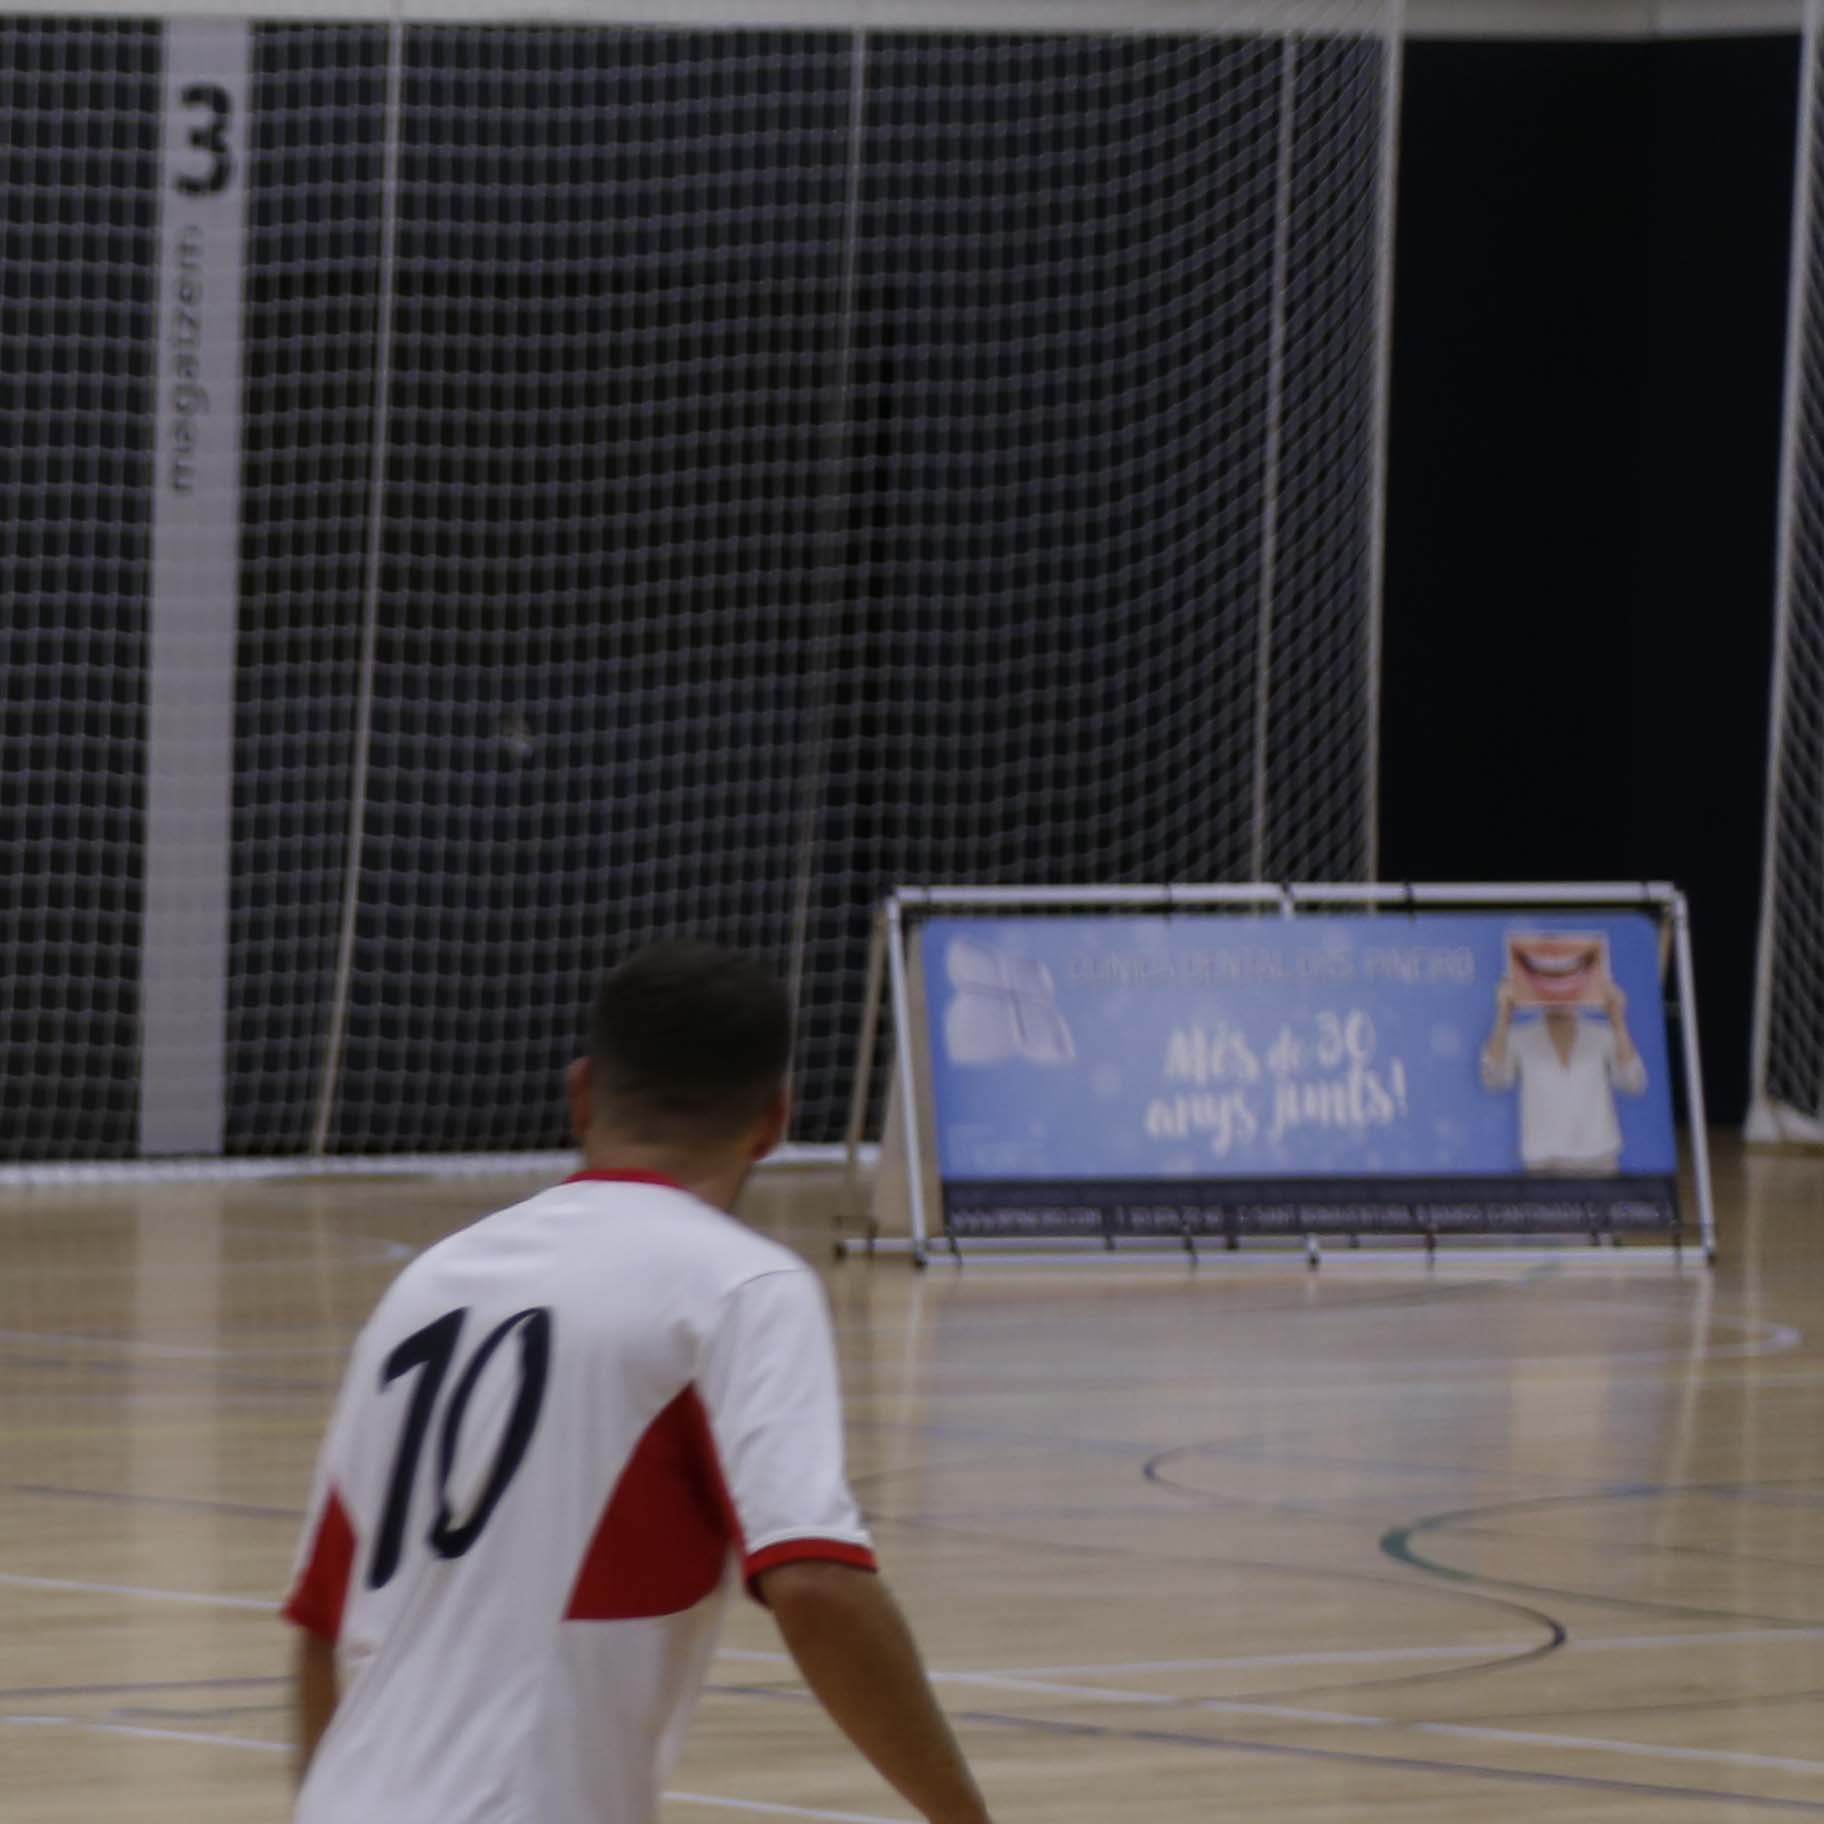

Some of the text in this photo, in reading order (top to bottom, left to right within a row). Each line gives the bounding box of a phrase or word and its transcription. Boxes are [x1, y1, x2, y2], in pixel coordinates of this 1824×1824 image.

[173, 80, 236, 197] 3
[1313, 1008, 1377, 1072] 30
[366, 1305, 556, 1591] 10
